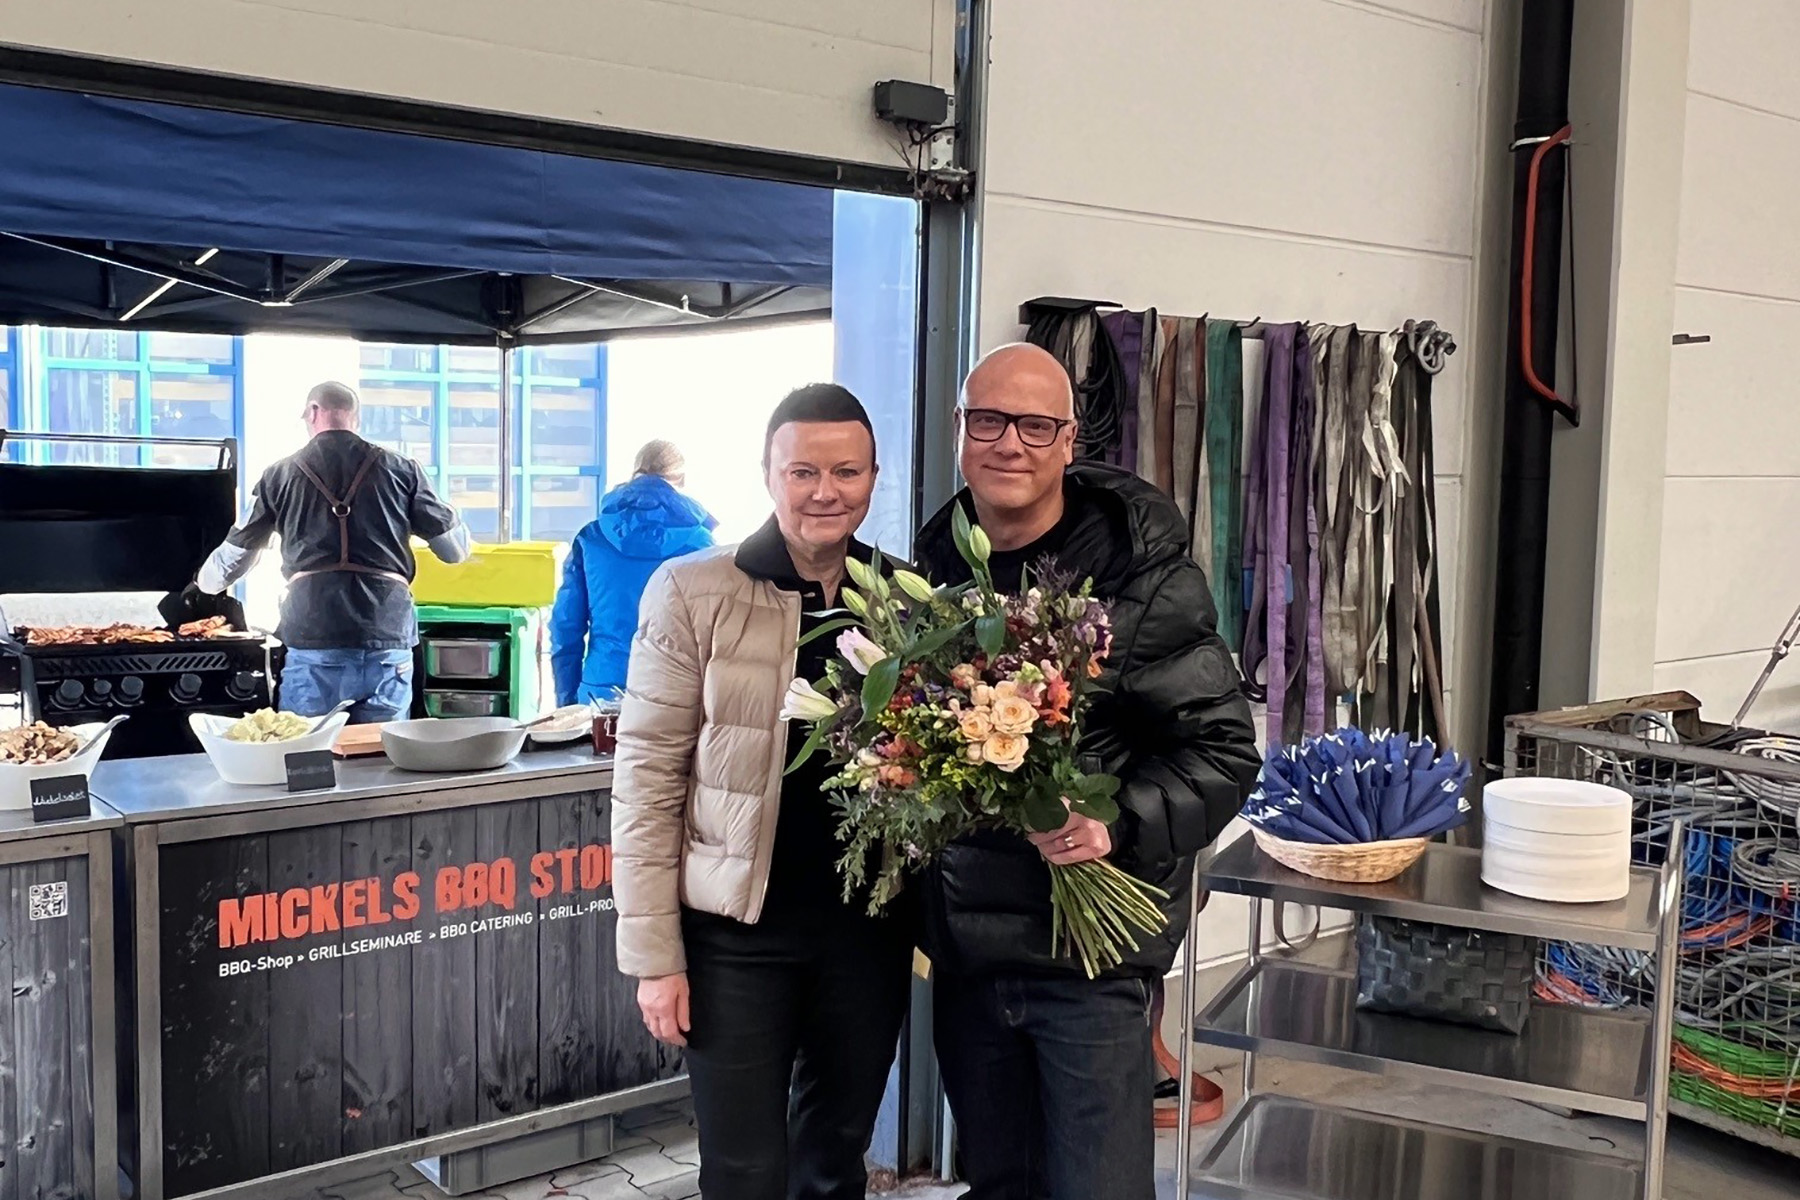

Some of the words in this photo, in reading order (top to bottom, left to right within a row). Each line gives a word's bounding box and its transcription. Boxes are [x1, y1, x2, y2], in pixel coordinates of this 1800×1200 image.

[218, 871, 420, 948] MICKELS
[435, 857, 516, 914] BBQ
[219, 954, 294, 977] BBQ-Shop
[308, 930, 423, 962] GRILLSEMINARE
[440, 924, 467, 939] BBQ
[470, 912, 533, 934] CATERING
